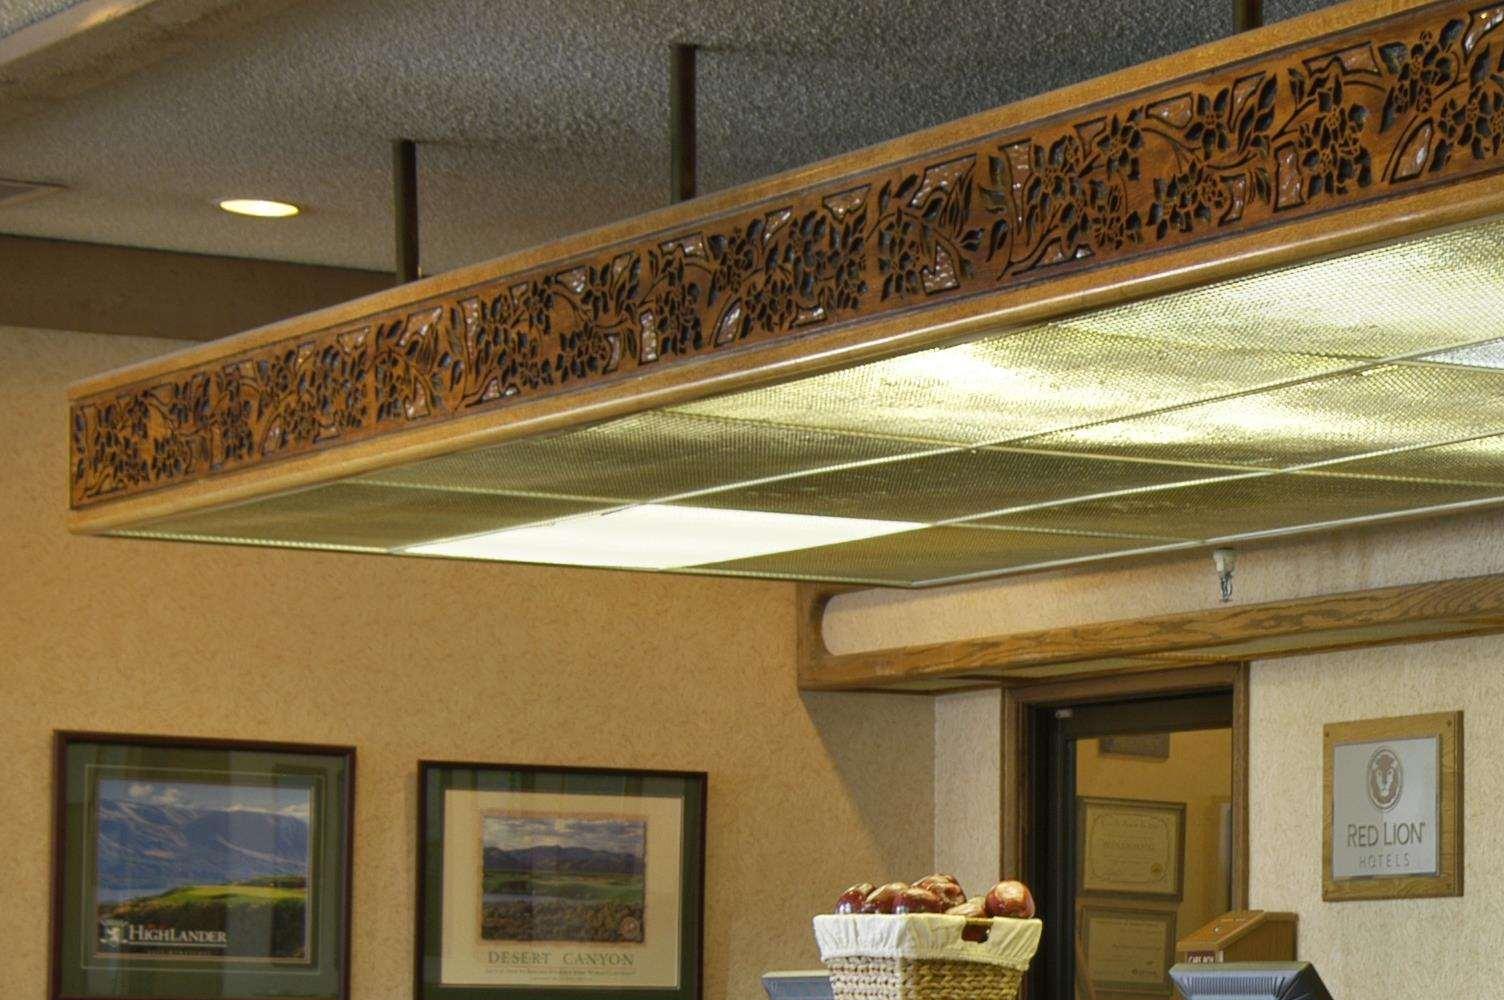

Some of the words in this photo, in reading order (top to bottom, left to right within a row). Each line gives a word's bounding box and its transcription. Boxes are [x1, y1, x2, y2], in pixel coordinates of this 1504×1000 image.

[1348, 823, 1379, 848] RED
[1384, 822, 1425, 846] LION
[1359, 852, 1410, 869] HOTELS
[129, 924, 227, 942] HIGHLANDER
[488, 950, 550, 965] DESERT
[562, 951, 635, 966] CANYON
